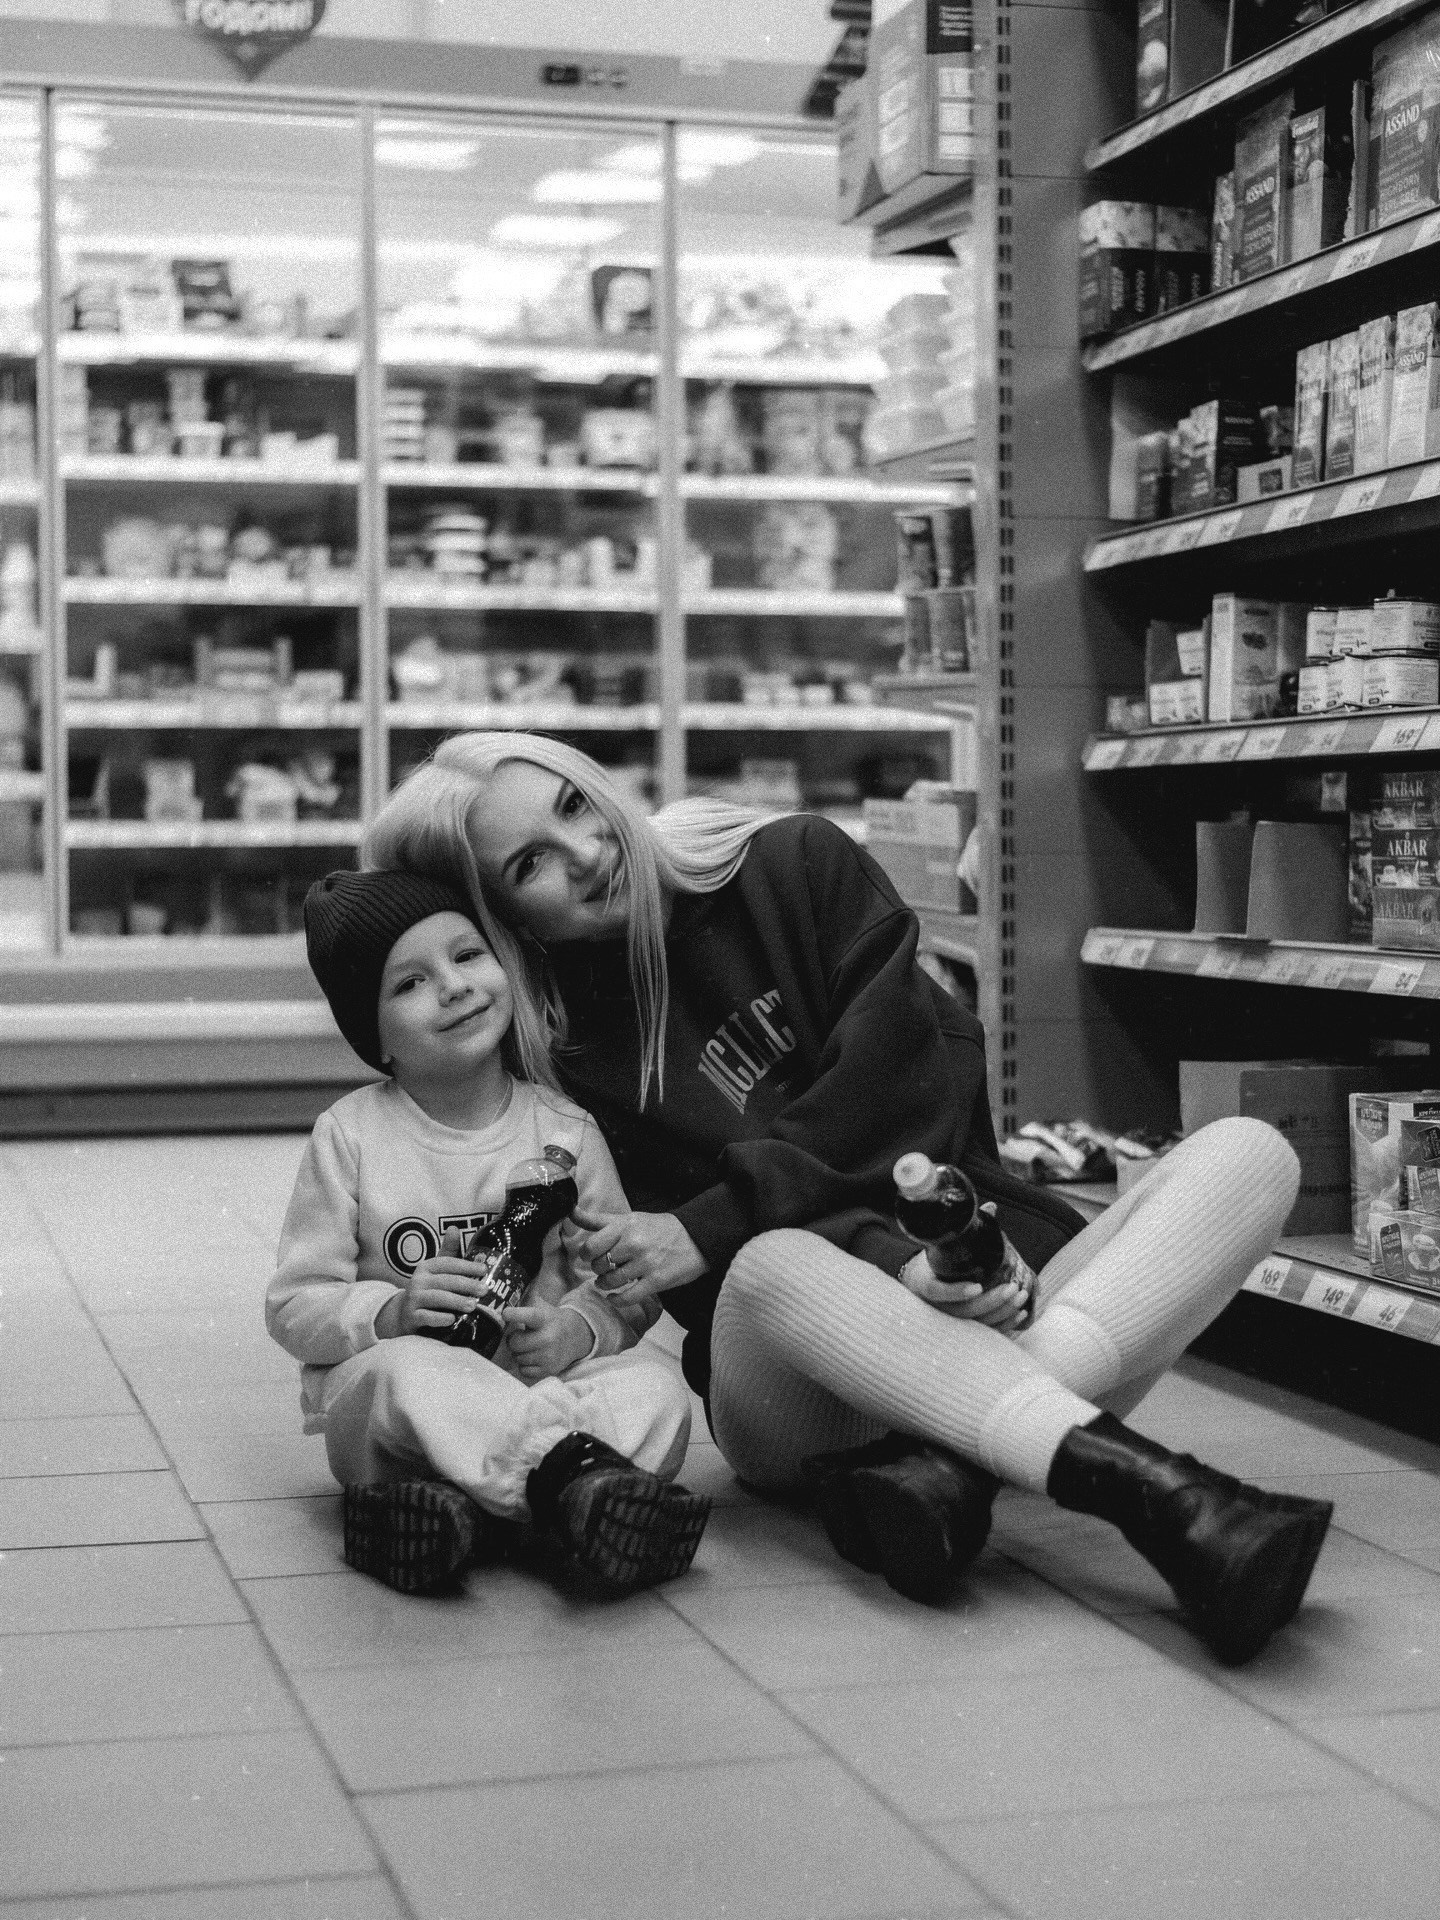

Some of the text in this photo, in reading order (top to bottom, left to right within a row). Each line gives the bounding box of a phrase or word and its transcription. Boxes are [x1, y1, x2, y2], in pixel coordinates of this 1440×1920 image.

[1385, 104, 1420, 137] ASSAND
[1383, 780, 1424, 798] AKBAR
[1386, 839, 1427, 856] AKBAR
[1260, 1268, 1280, 1286] 169
[1322, 1287, 1344, 1306] 149
[1378, 1304, 1398, 1322] 46
